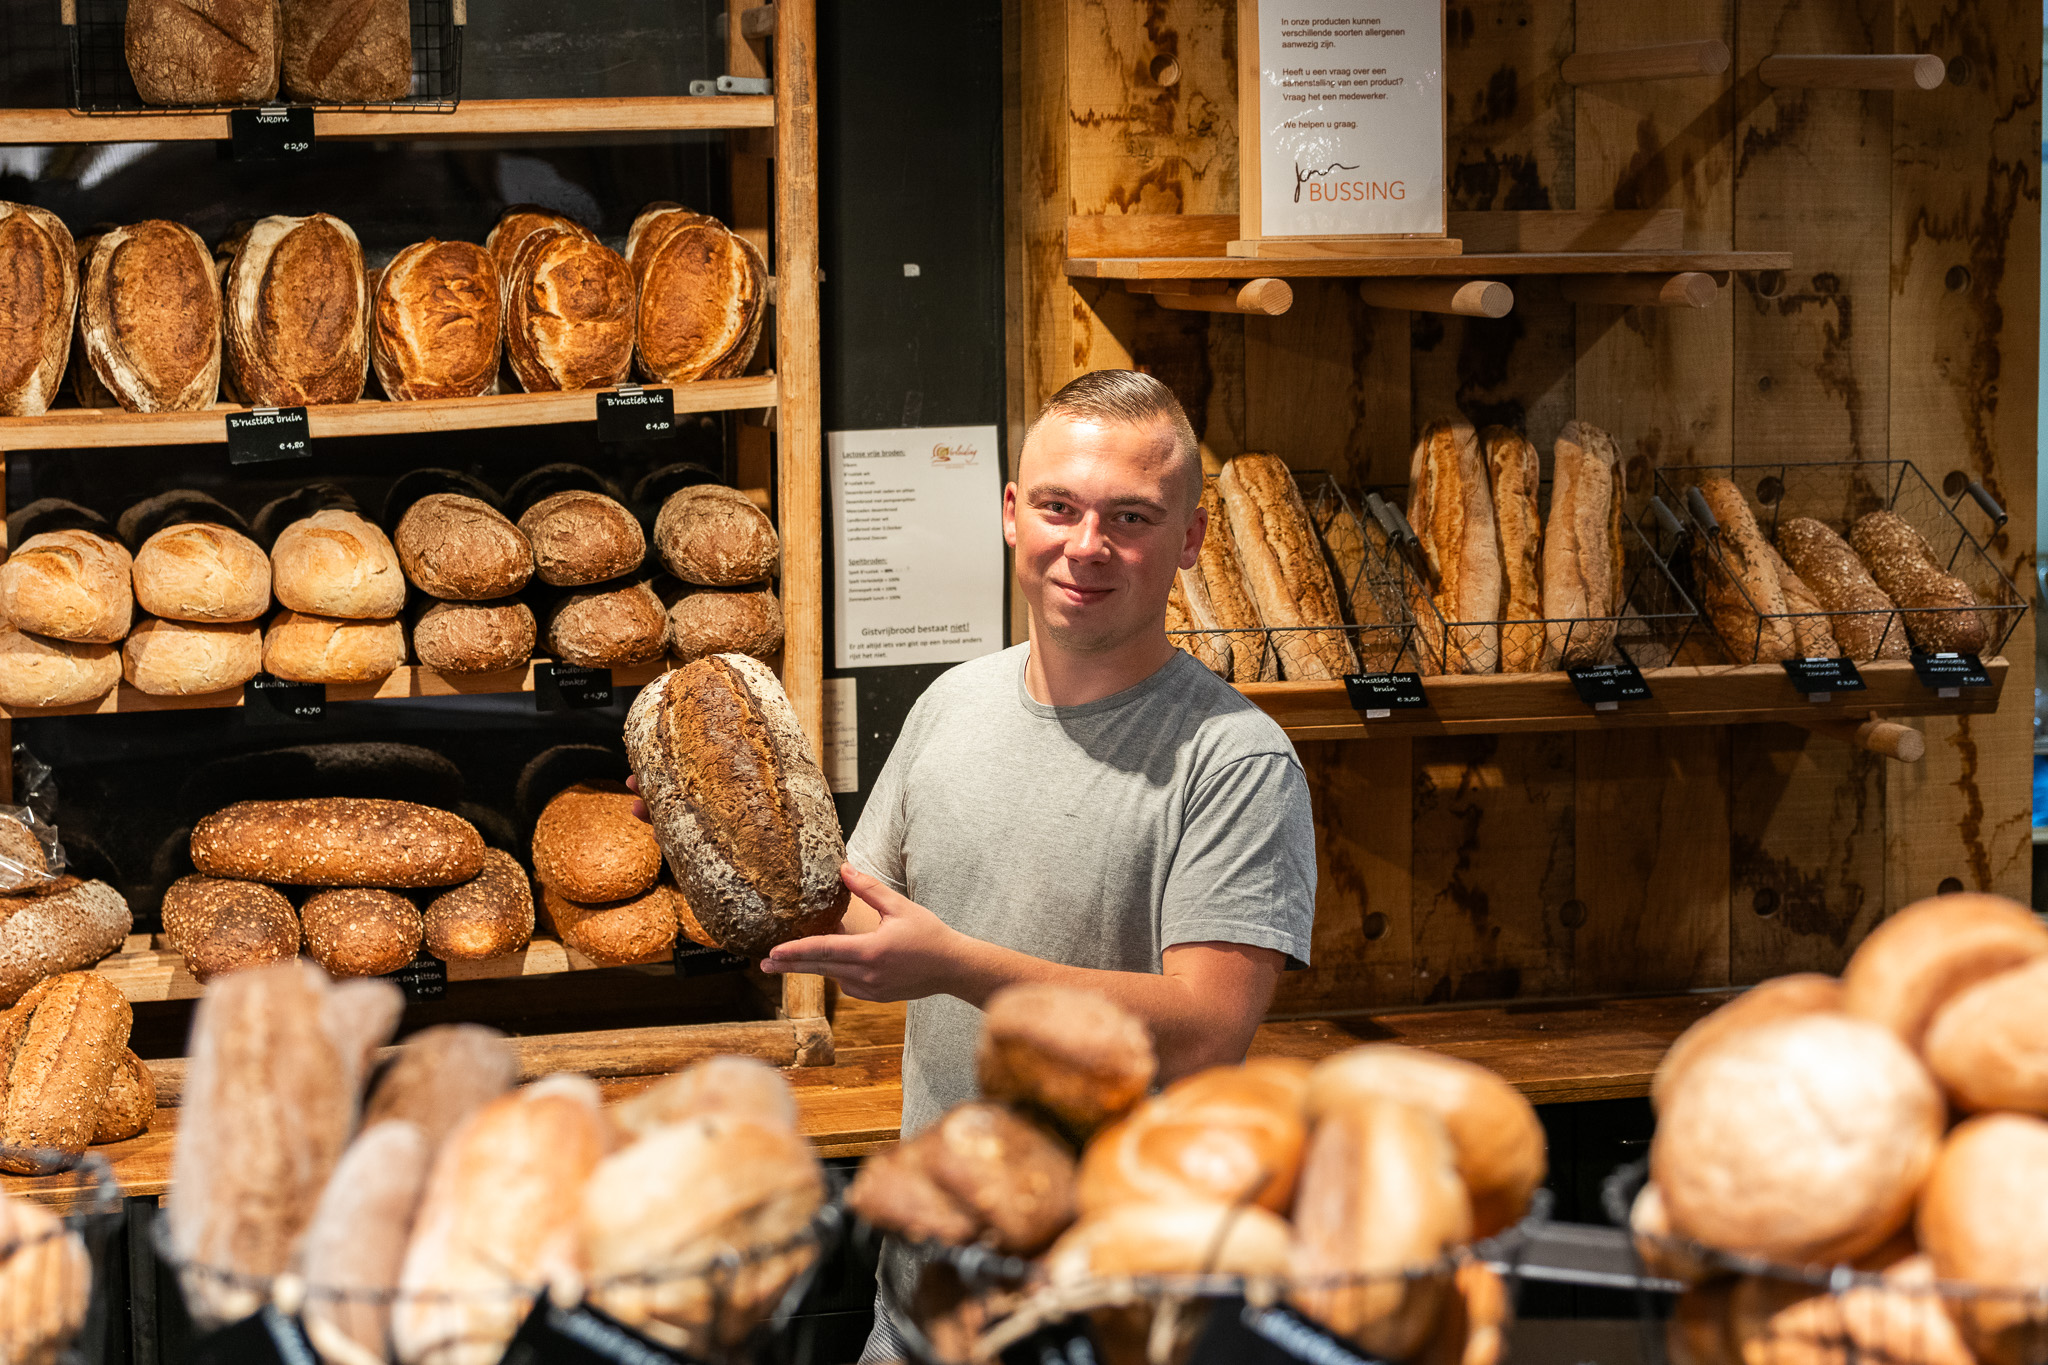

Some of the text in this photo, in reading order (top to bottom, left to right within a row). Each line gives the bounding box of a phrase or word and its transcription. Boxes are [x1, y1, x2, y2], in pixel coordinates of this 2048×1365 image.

[1281, 18, 1289, 26] In
[1312, 18, 1350, 27] producten
[1281, 28, 1405, 37] verschillende soorten allergenen
[1281, 40, 1336, 50] aanwezig zijn.
[1282, 68, 1304, 76] Heeft
[1329, 69, 1351, 77] vraag
[1370, 78, 1404, 87] product?
[1282, 93, 1306, 102] Vraag
[1308, 93, 1321, 101] het
[1339, 92, 1389, 100] medewerker.
[256, 116, 290, 124] Vikorn
[1298, 121, 1325, 130] helpen
[1333, 121, 1359, 129] graag.
[1310, 181, 1406, 202] BUSSING
[606, 394, 664, 406] B'rustiek wit
[231, 412, 303, 428] B'rustiek bruin
[652, 422, 670, 430] 4,80
[286, 441, 305, 450] 4,80
[842, 449, 906, 459] Lactose vrije broden:
[861, 622, 970, 637] Gistvrijbrood bestaat niet!
[866, 642, 882, 651] altijd
[907, 641, 918, 649] gist
[559, 679, 588, 687] donker
[1352, 676, 1412, 685] B'rustiek flute
